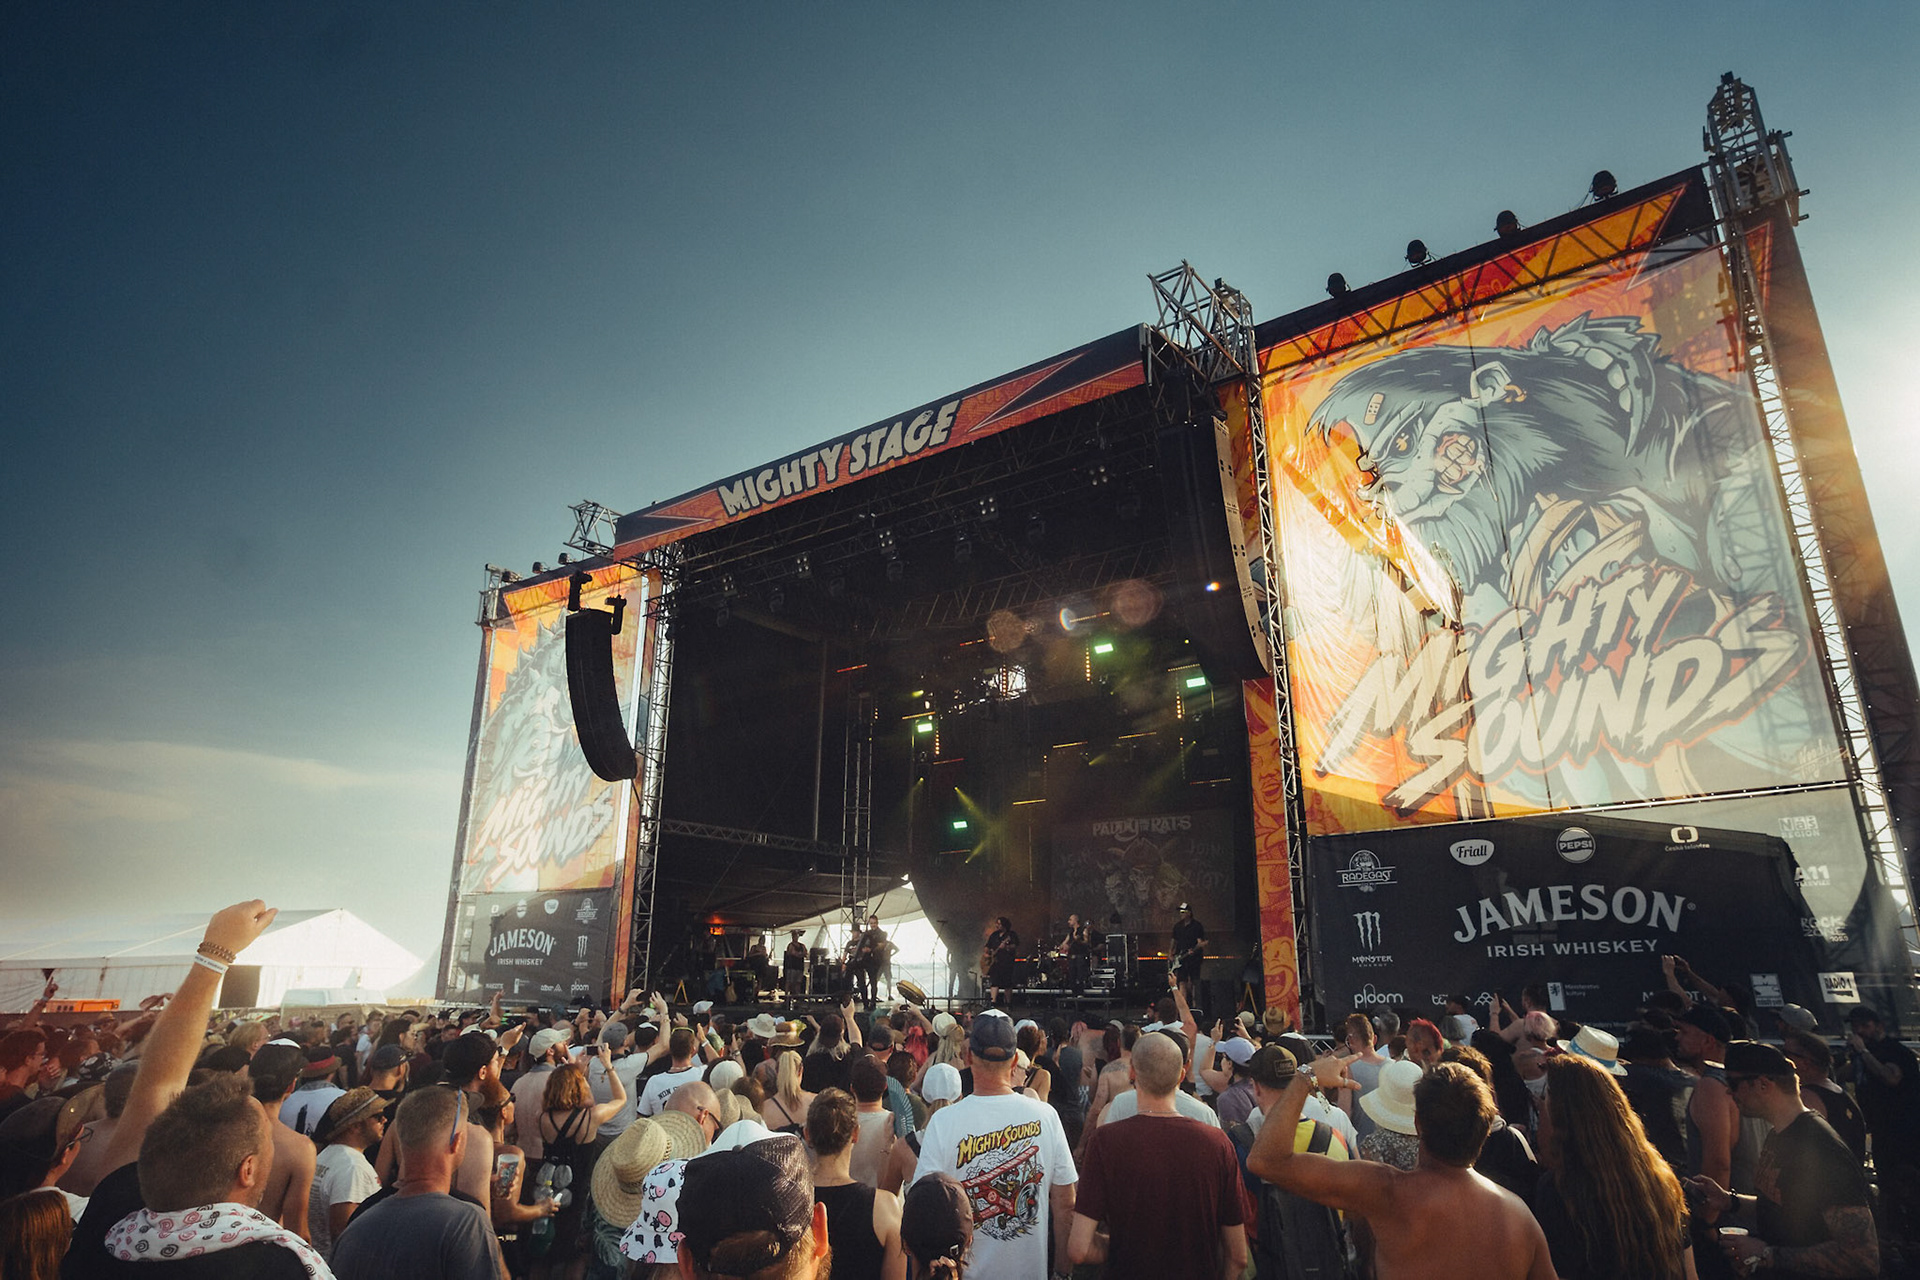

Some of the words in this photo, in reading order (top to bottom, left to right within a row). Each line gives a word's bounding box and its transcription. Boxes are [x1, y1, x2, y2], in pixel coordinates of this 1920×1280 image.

[717, 442, 844, 516] MIGHTY
[850, 400, 960, 474] STAGE
[1314, 567, 1682, 774] MIGHTY
[1385, 601, 1801, 808] SOUNDS
[1150, 815, 1192, 835] RATS
[490, 786, 614, 885] SOUNDS
[1559, 839, 1593, 850] PEPSI
[1456, 845, 1488, 859] Friall
[1341, 870, 1393, 884] RADEGAST
[1794, 866, 1830, 880] A11
[1801, 916, 1847, 928] ROCK
[490, 928, 555, 956] JAMESON
[1487, 943, 1545, 958] IRISH
[1554, 939, 1658, 955] WHISKEY
[497, 958, 514, 966] IRISH
[515, 957, 544, 966] WHISKEY
[1352, 955, 1393, 964] MONSTER
[1824, 978, 1847, 989] RADIO
[1354, 983, 1404, 1008] ploom
[956, 1129, 1003, 1169] MIGHTY
[1001, 1120, 1042, 1150] SOUNDS
